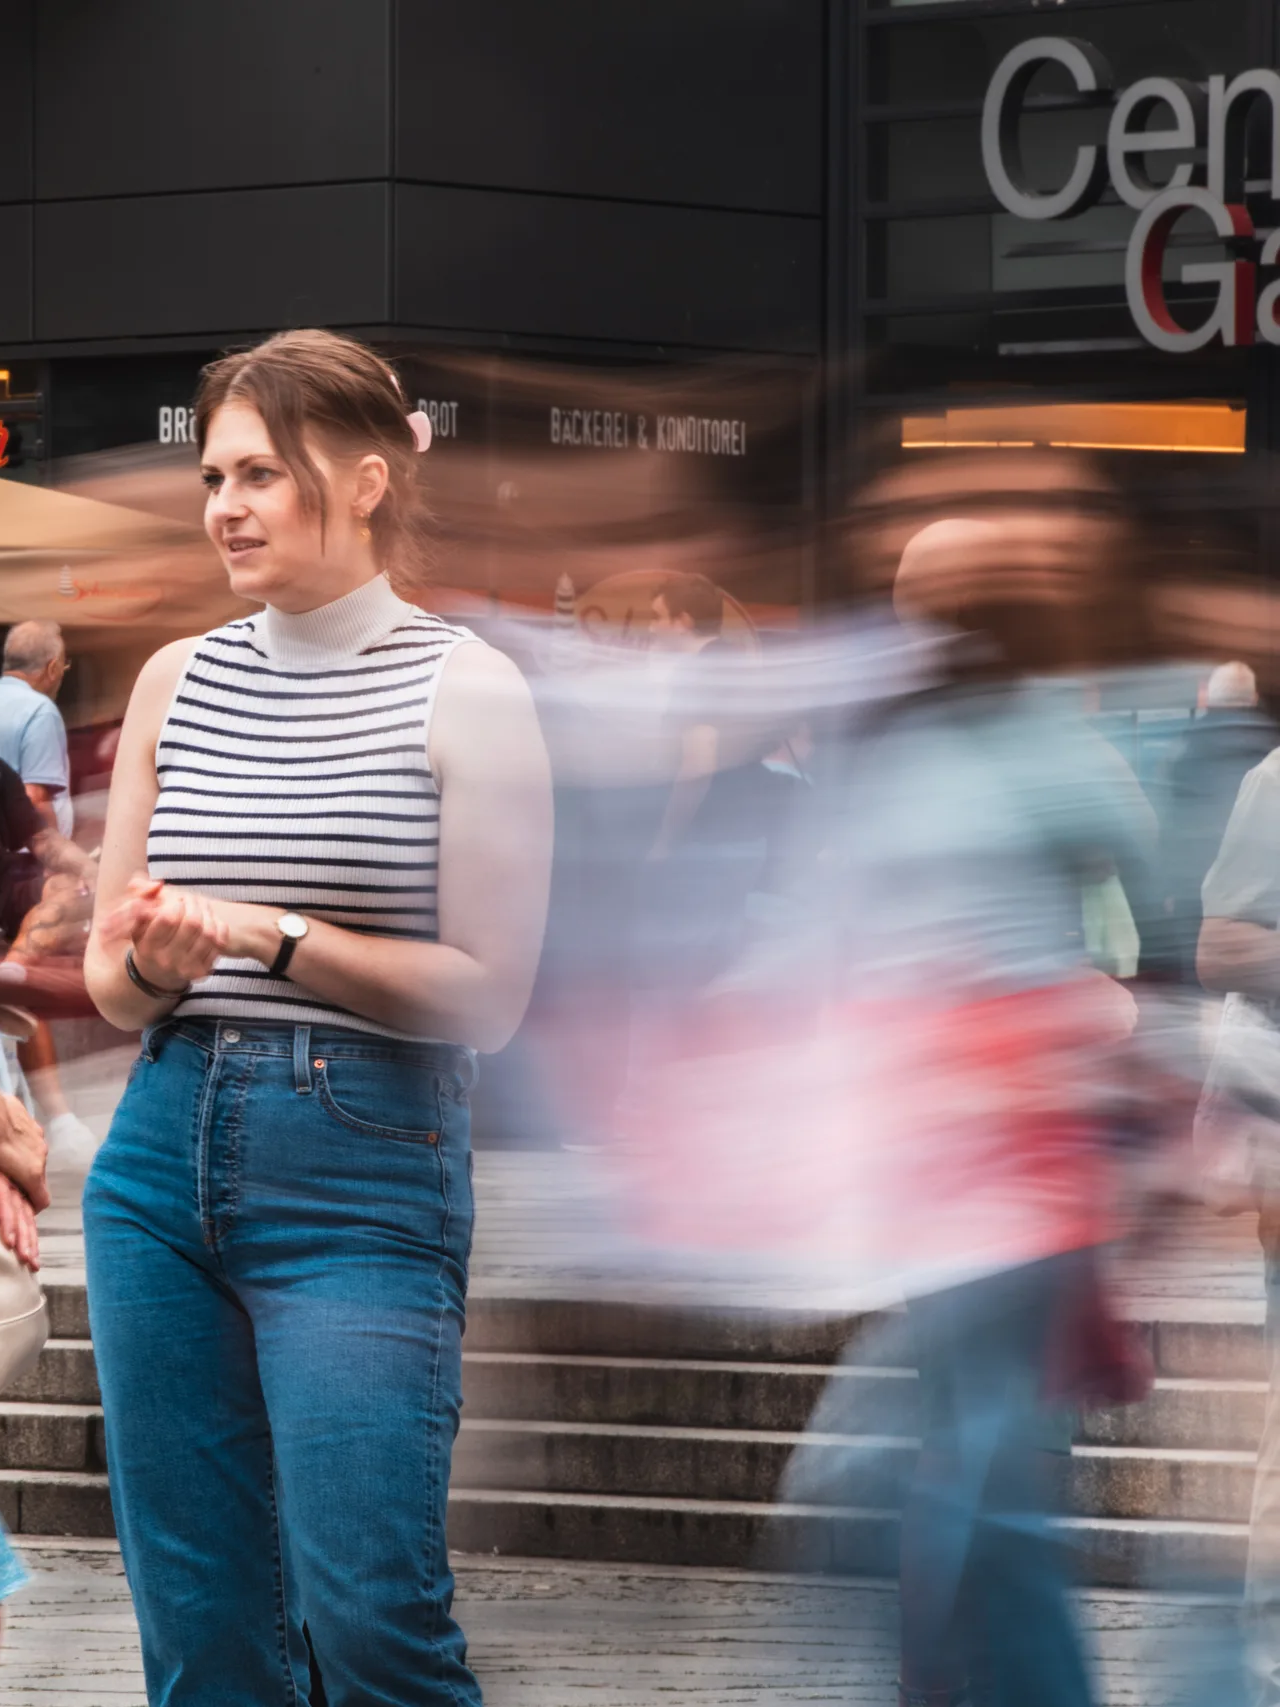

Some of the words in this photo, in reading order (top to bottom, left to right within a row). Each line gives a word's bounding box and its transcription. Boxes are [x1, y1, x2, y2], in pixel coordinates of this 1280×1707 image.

[981, 36, 1280, 219] Cen
[550, 406, 629, 449] BÄCKEREI
[637, 415, 649, 450] &
[656, 414, 746, 456] KONDITOREI
